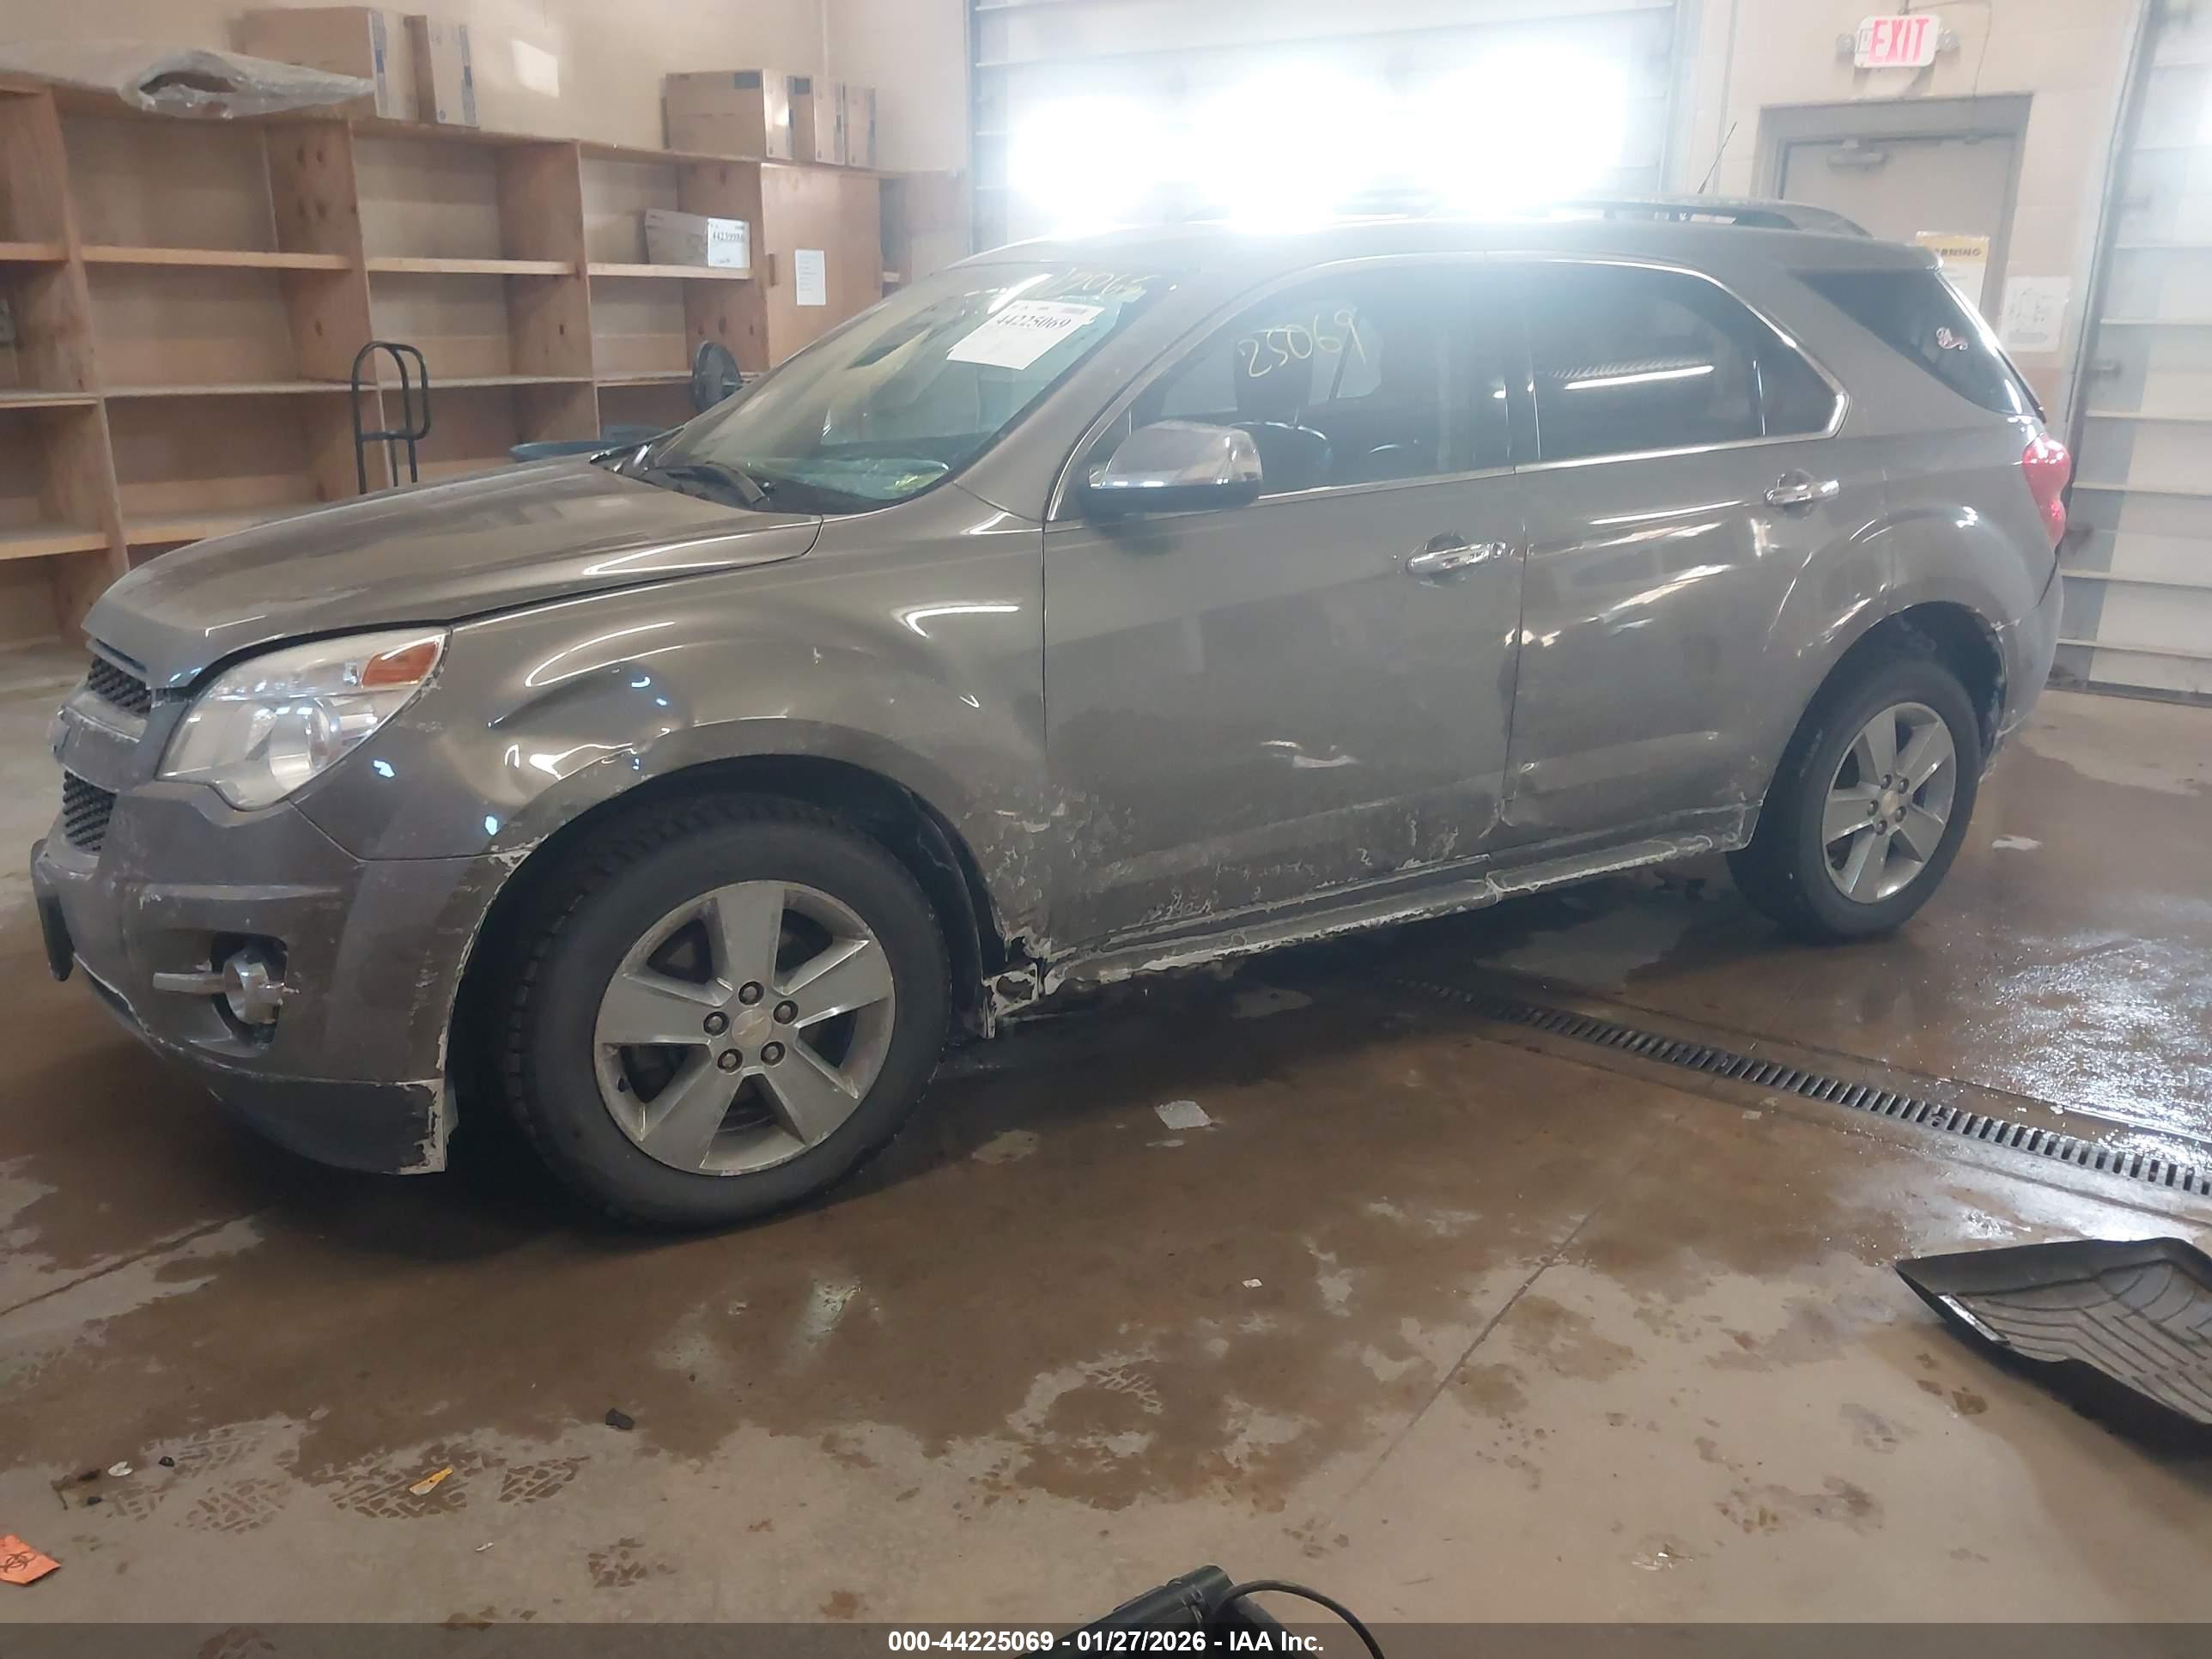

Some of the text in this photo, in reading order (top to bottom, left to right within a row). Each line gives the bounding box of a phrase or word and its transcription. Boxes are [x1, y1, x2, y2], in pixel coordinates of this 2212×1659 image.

[1869, 19, 1929, 63] EXIT
[996, 314, 1073, 330] 44225069
[1237, 309, 1367, 378] 25069
